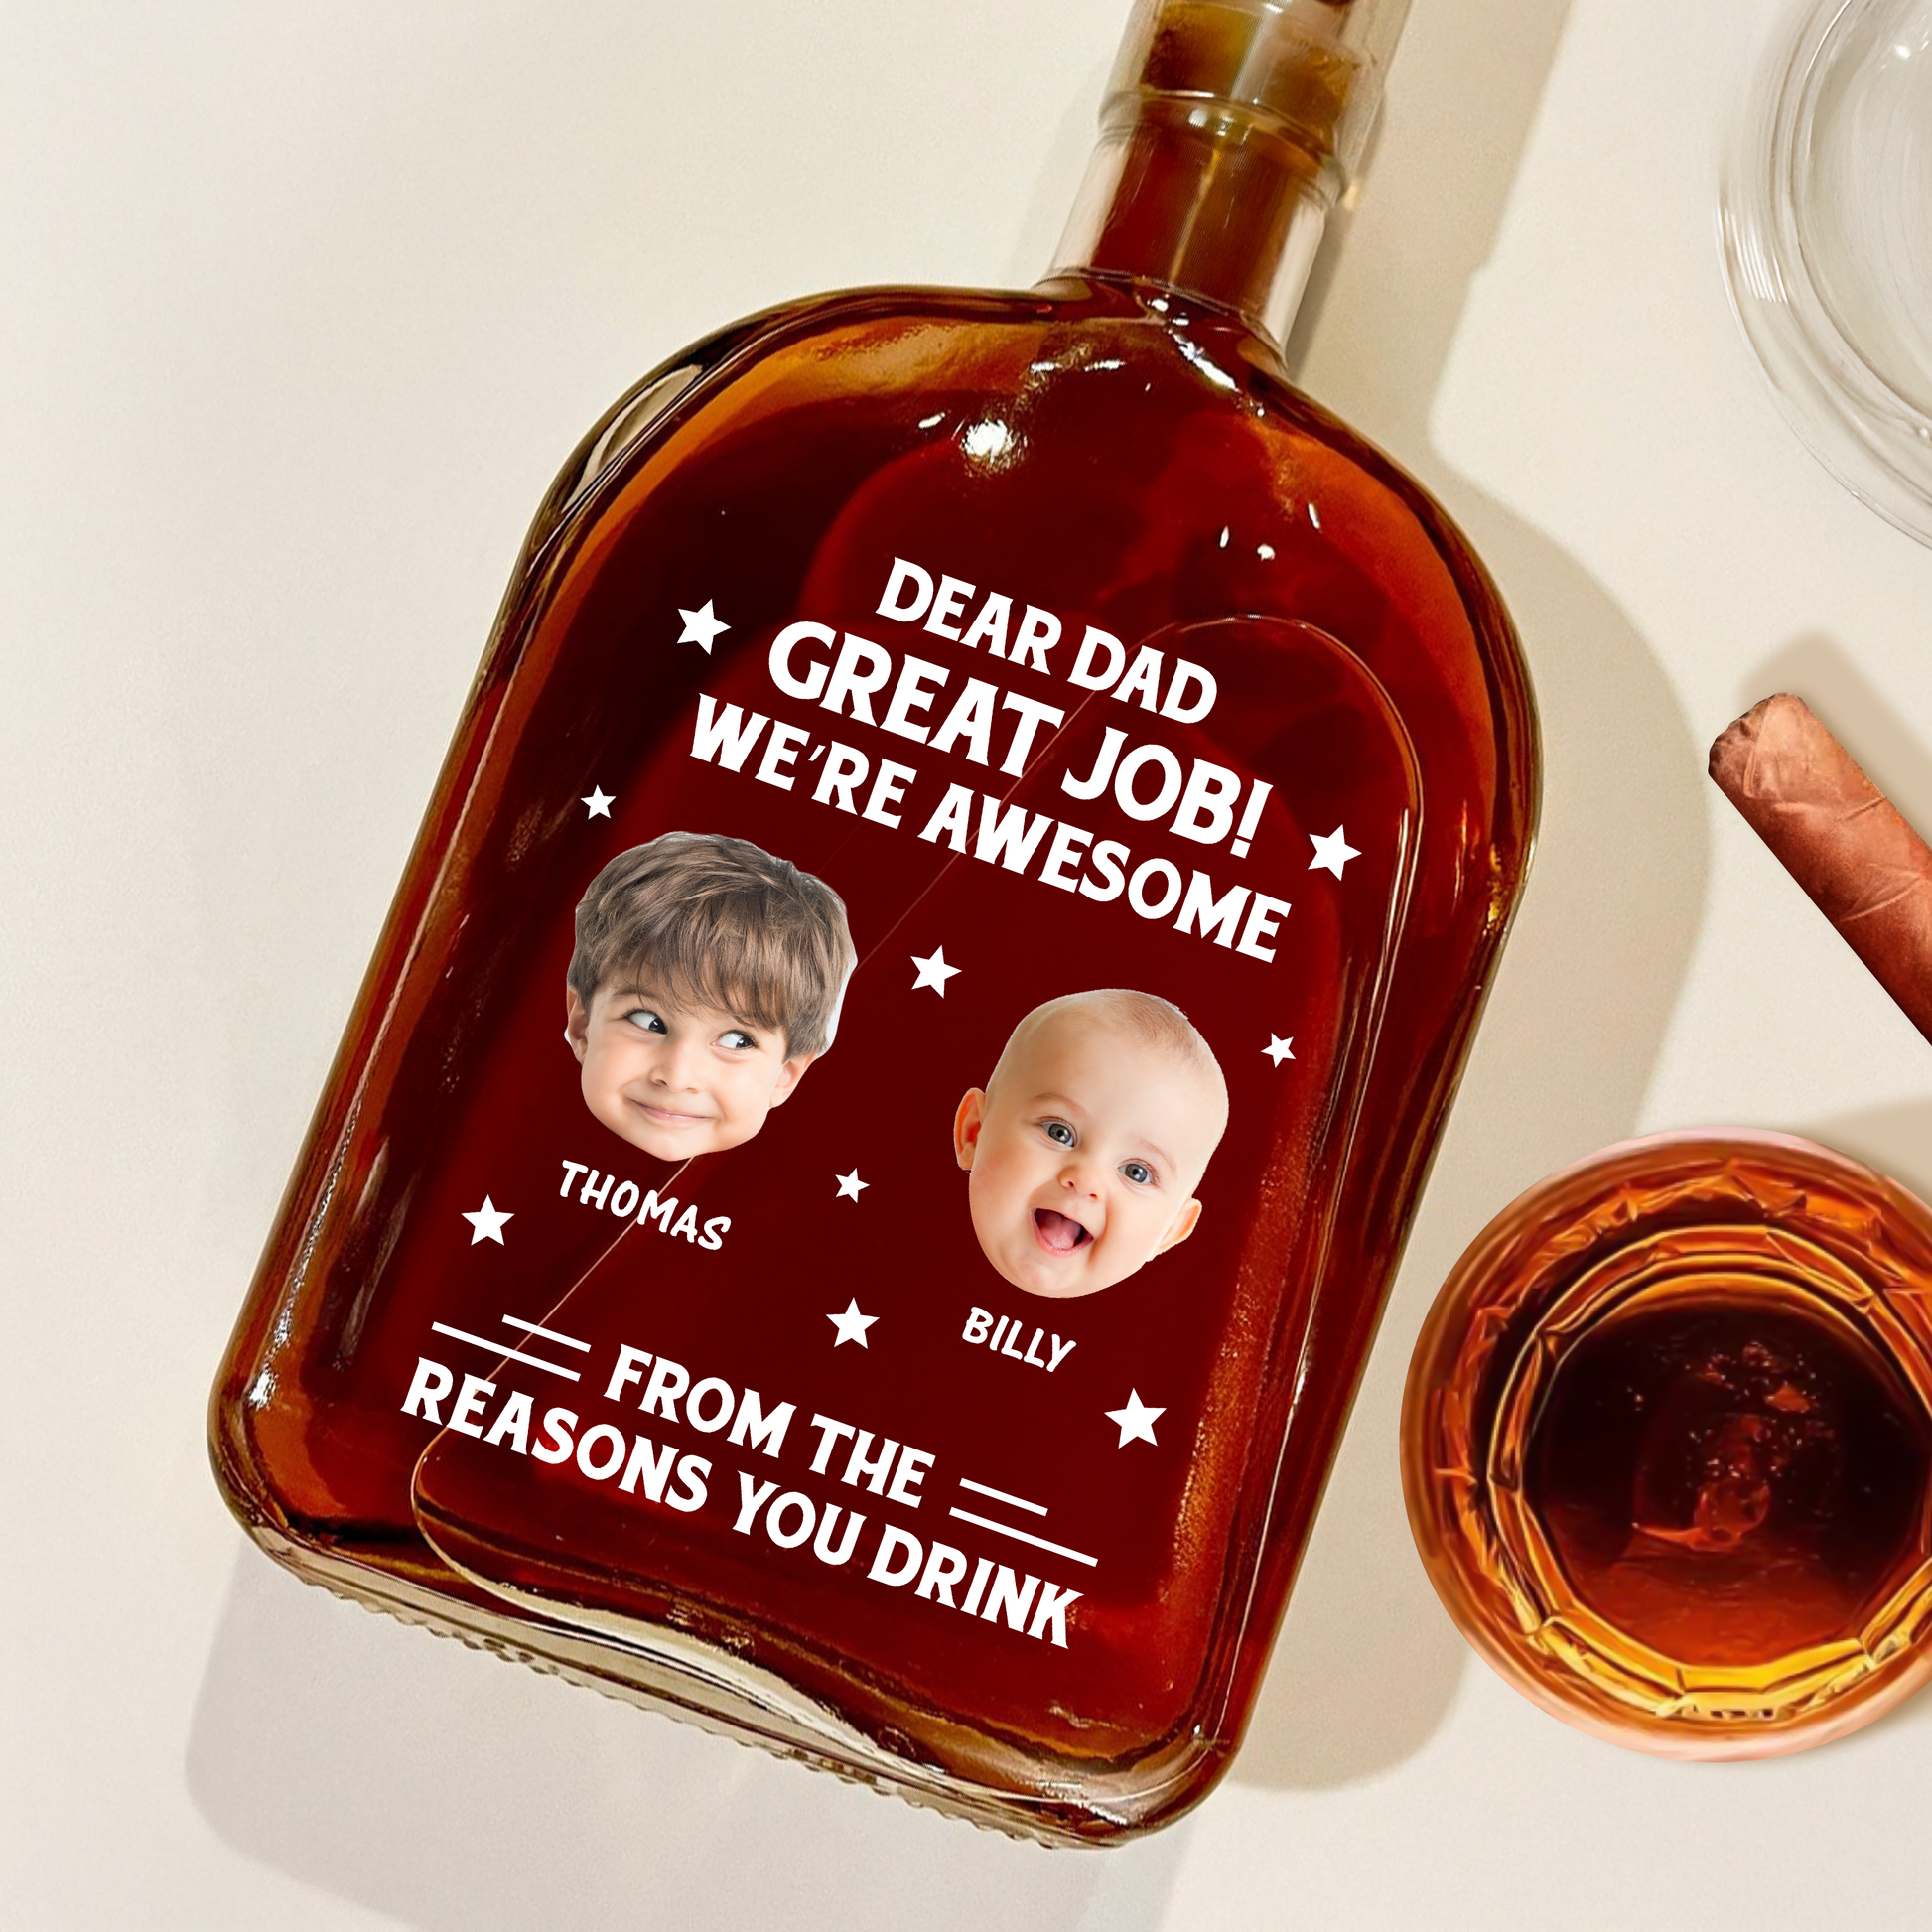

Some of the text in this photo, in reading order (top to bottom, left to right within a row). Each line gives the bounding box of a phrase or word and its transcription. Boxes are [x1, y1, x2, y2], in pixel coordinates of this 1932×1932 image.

[875, 556, 1217, 724] DEAR DAD
[768, 621, 1274, 859] GREAT JOB!
[689, 692, 1292, 964] WE'RE AWESOME
[559, 1159, 732, 1251] THOMAS
[962, 1306, 1077, 1373] BILLY
[400, 1356, 1084, 1649] REASONS YOU DRINK
[603, 1343, 936, 1509] FROM THE
